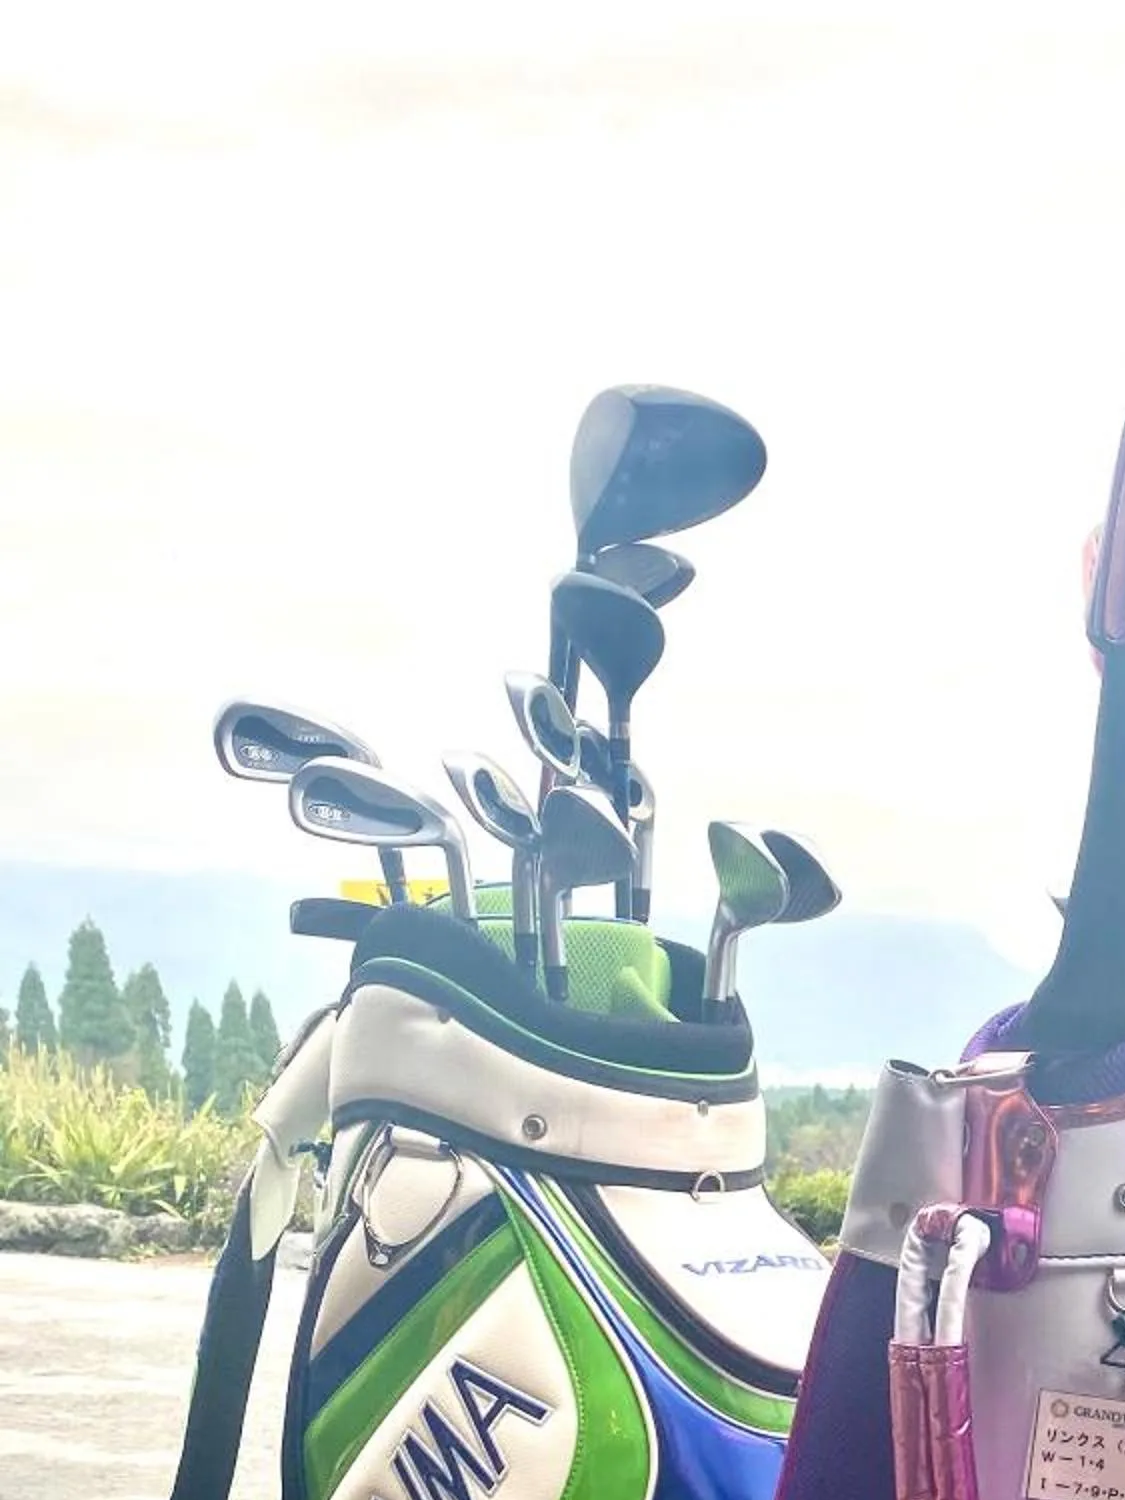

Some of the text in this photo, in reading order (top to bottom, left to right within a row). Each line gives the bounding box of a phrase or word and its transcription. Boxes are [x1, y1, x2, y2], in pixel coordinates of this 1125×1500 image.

[681, 1254, 825, 1277] VIZARD
[1046, 1428, 1105, 1449] リンクス
